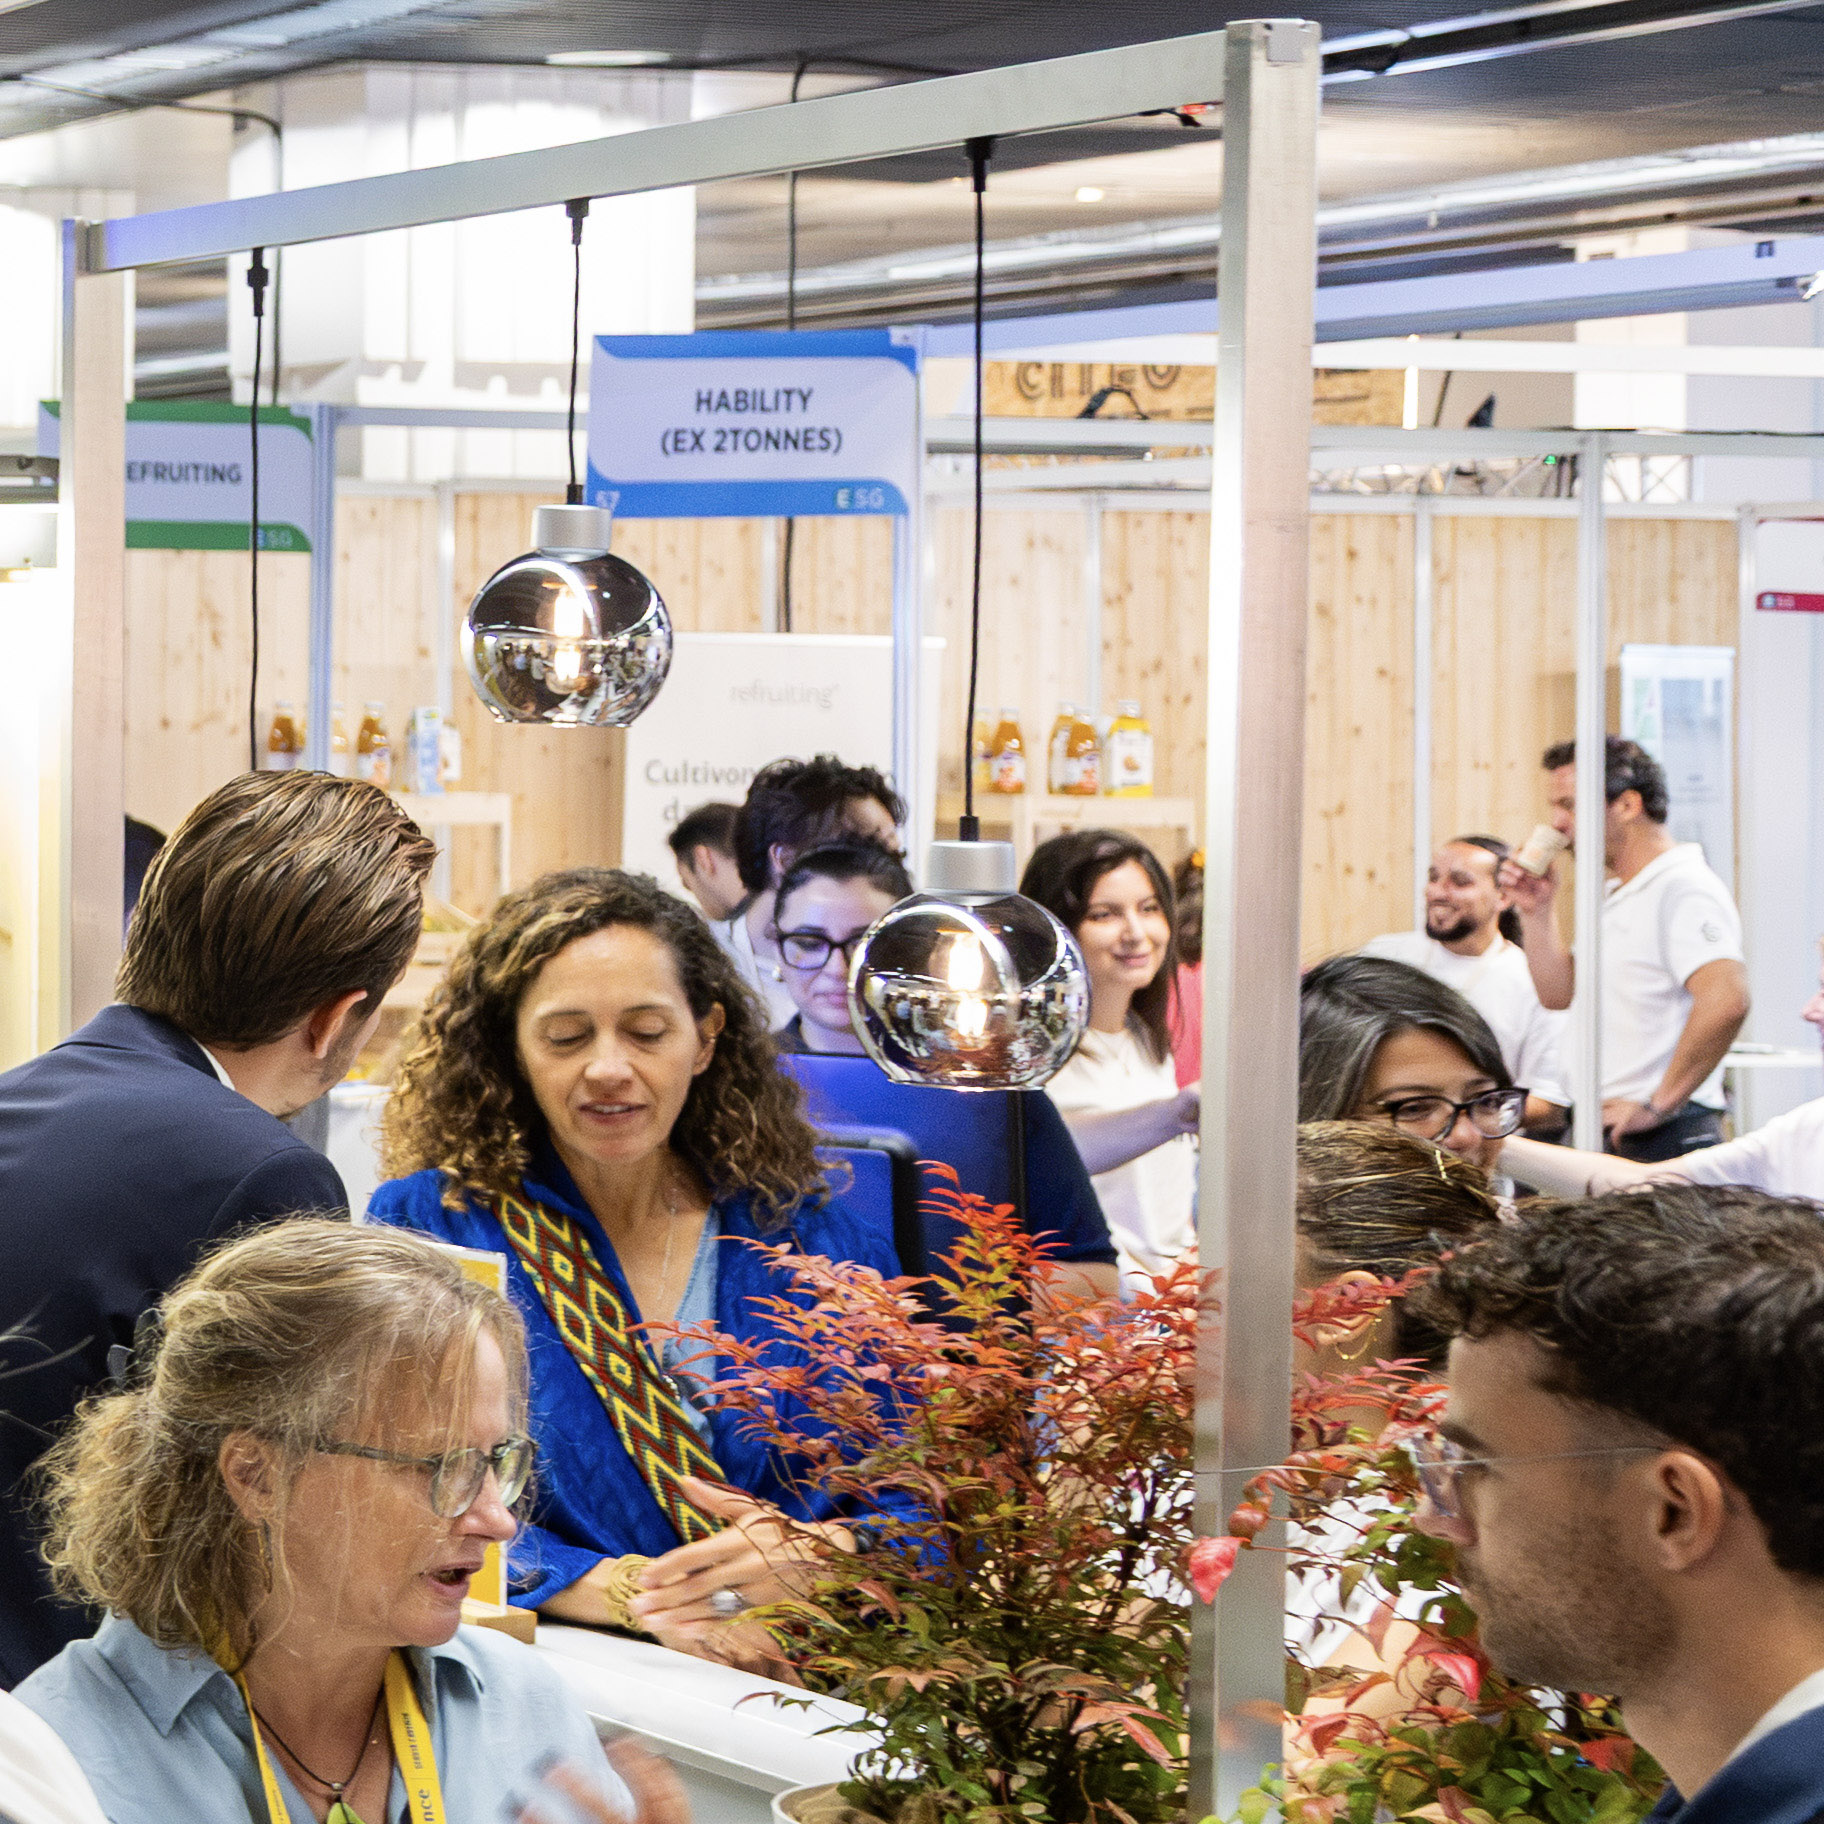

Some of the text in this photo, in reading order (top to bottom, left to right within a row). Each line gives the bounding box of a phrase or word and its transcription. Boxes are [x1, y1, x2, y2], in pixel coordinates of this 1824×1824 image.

[695, 387, 813, 413] HABILITY
[660, 427, 842, 456] (EX 2TONNES)
[126, 460, 242, 484] EFRUITING
